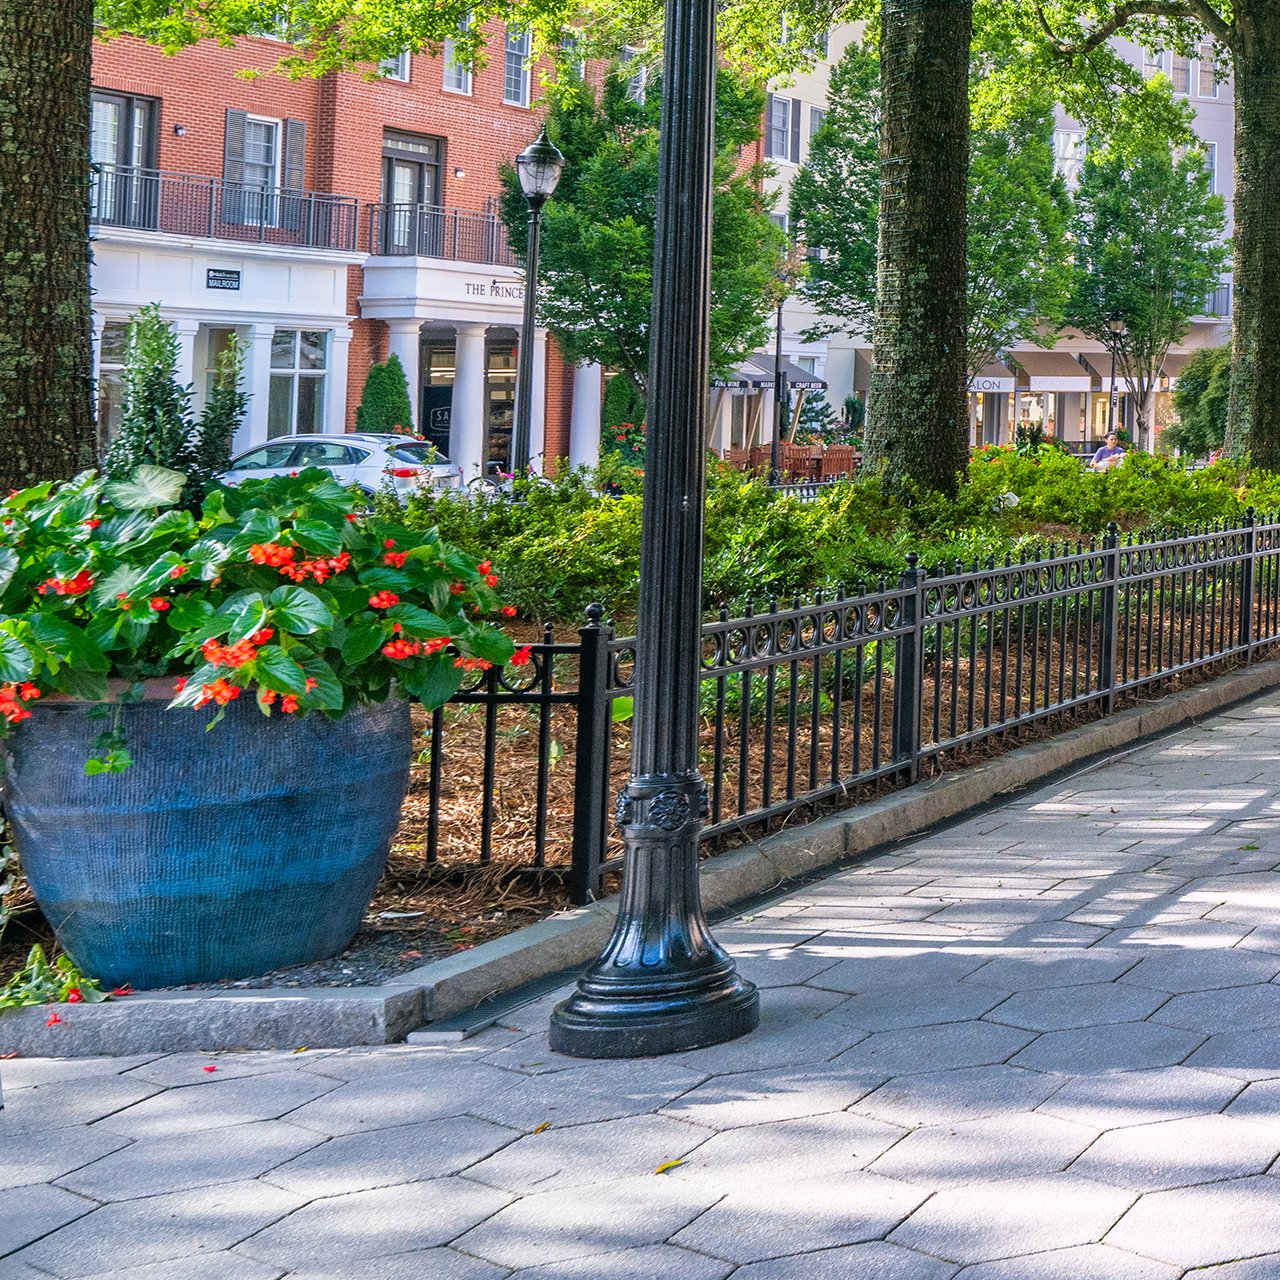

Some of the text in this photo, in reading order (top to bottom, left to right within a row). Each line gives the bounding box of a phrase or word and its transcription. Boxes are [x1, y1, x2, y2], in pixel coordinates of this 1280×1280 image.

[208, 279, 239, 289] MAILROOM
[465, 283, 525, 299] THE PRINCE
[969, 380, 1001, 390] ALON
[437, 410, 449, 421] SA
